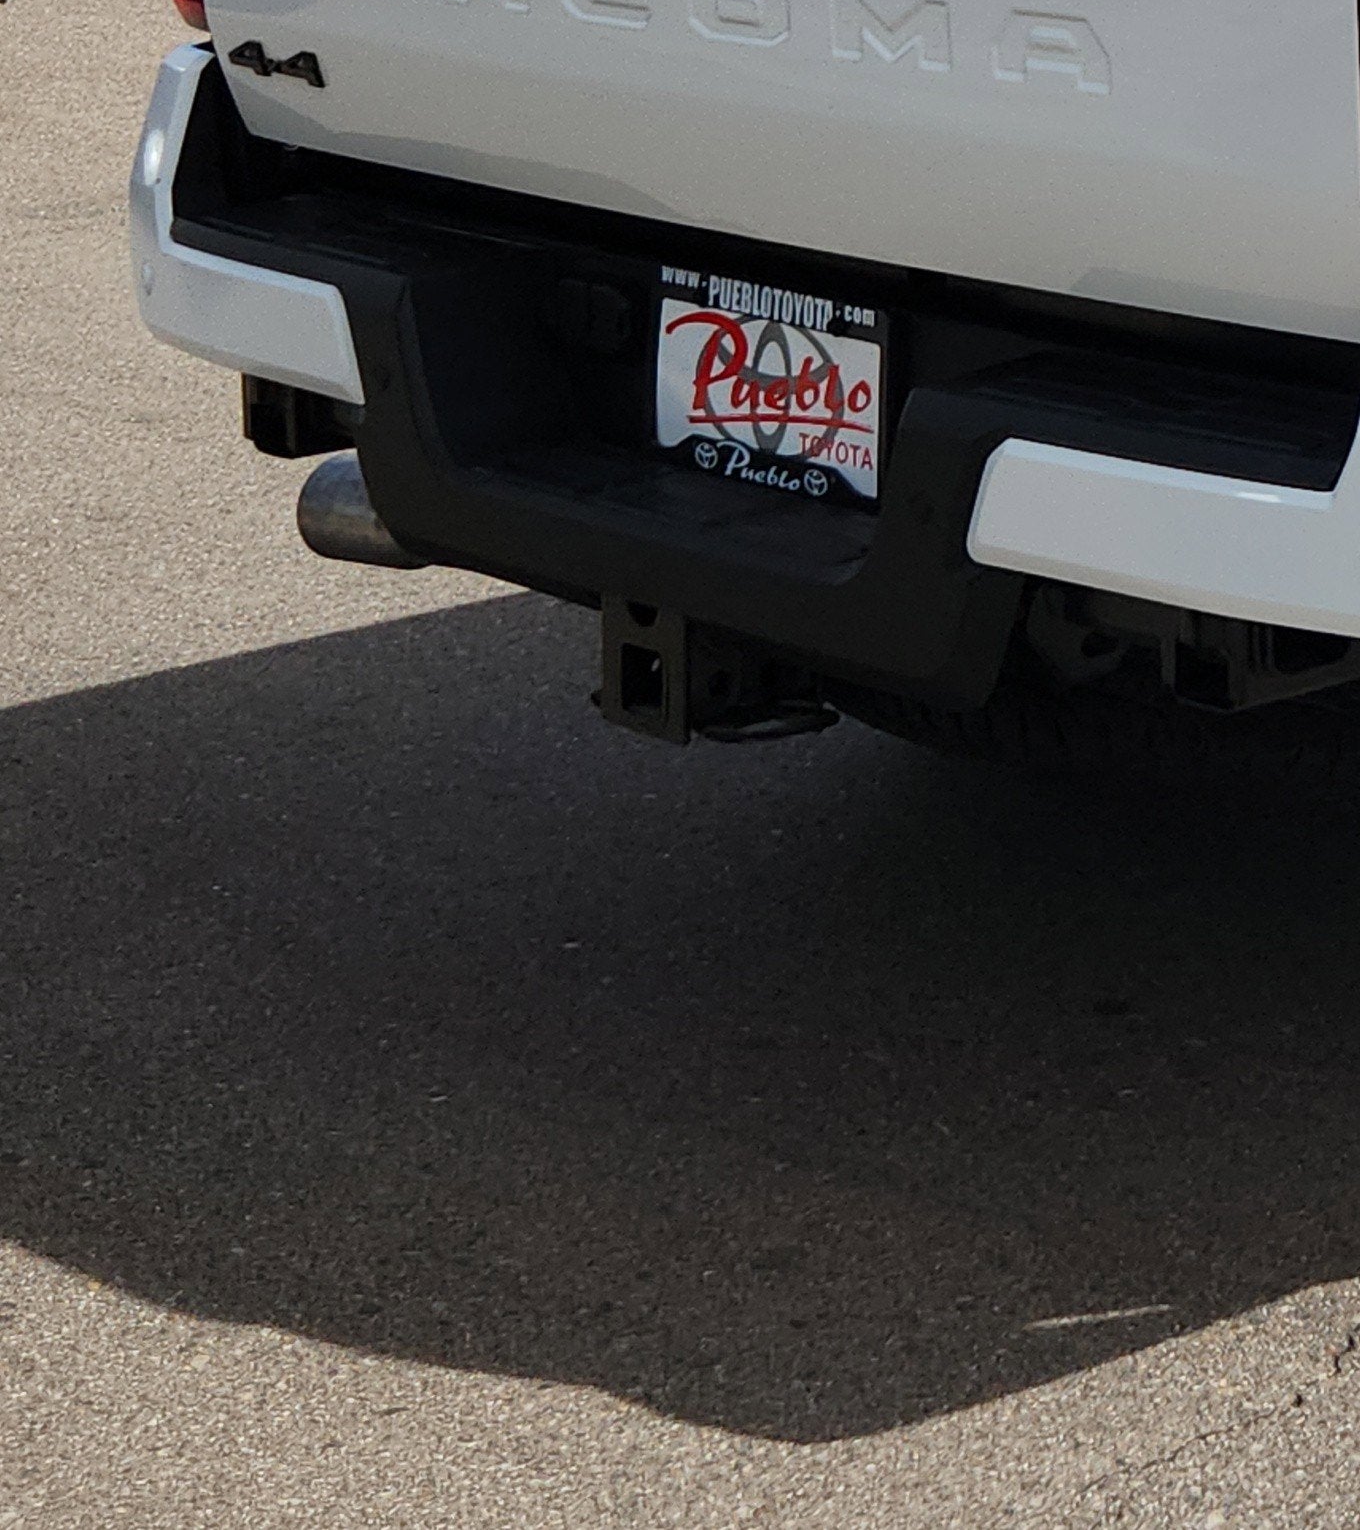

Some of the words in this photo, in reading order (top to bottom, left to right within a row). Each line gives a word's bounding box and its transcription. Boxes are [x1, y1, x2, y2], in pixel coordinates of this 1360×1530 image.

[665, 311, 873, 413] Pueblo
[716, 440, 800, 492] Pueblo
[799, 431, 874, 471] TOYOTA
